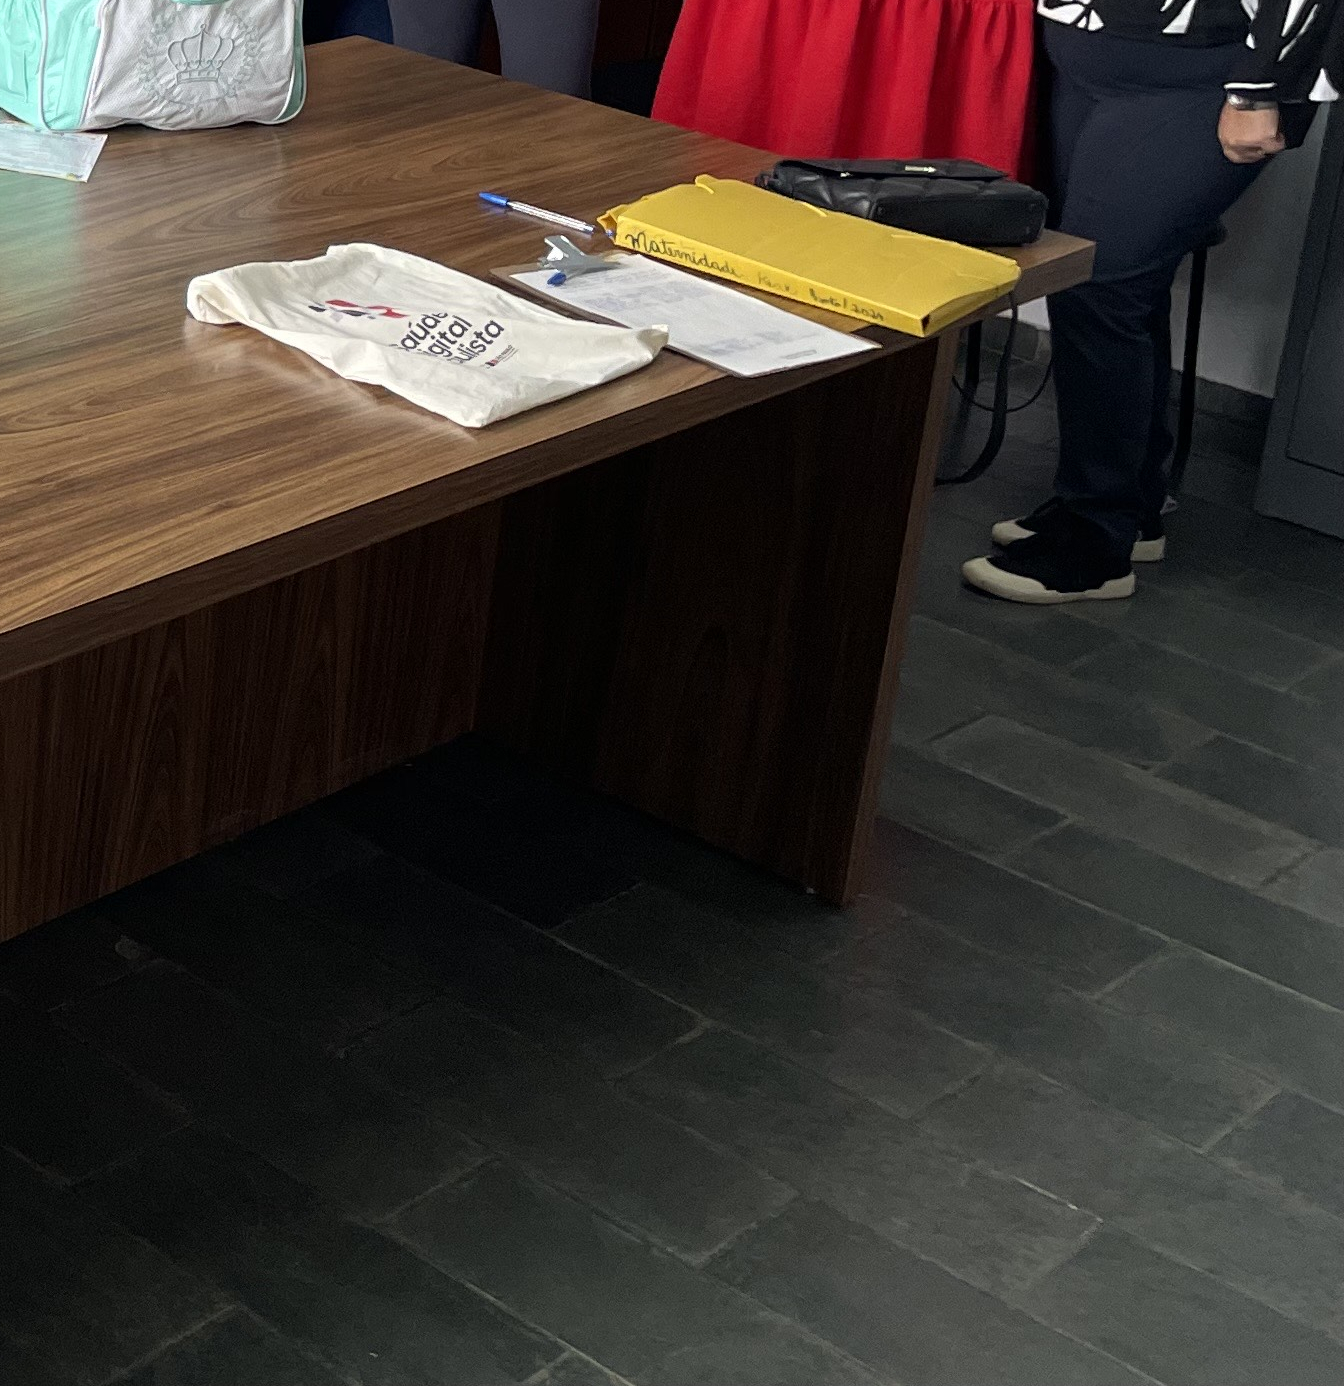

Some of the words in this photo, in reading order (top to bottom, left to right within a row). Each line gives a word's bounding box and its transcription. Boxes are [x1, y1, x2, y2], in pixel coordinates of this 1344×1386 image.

[625, 230, 742, 278] Maternidade
[394, 312, 449, 351] aúde
[425, 314, 473, 358] gital
